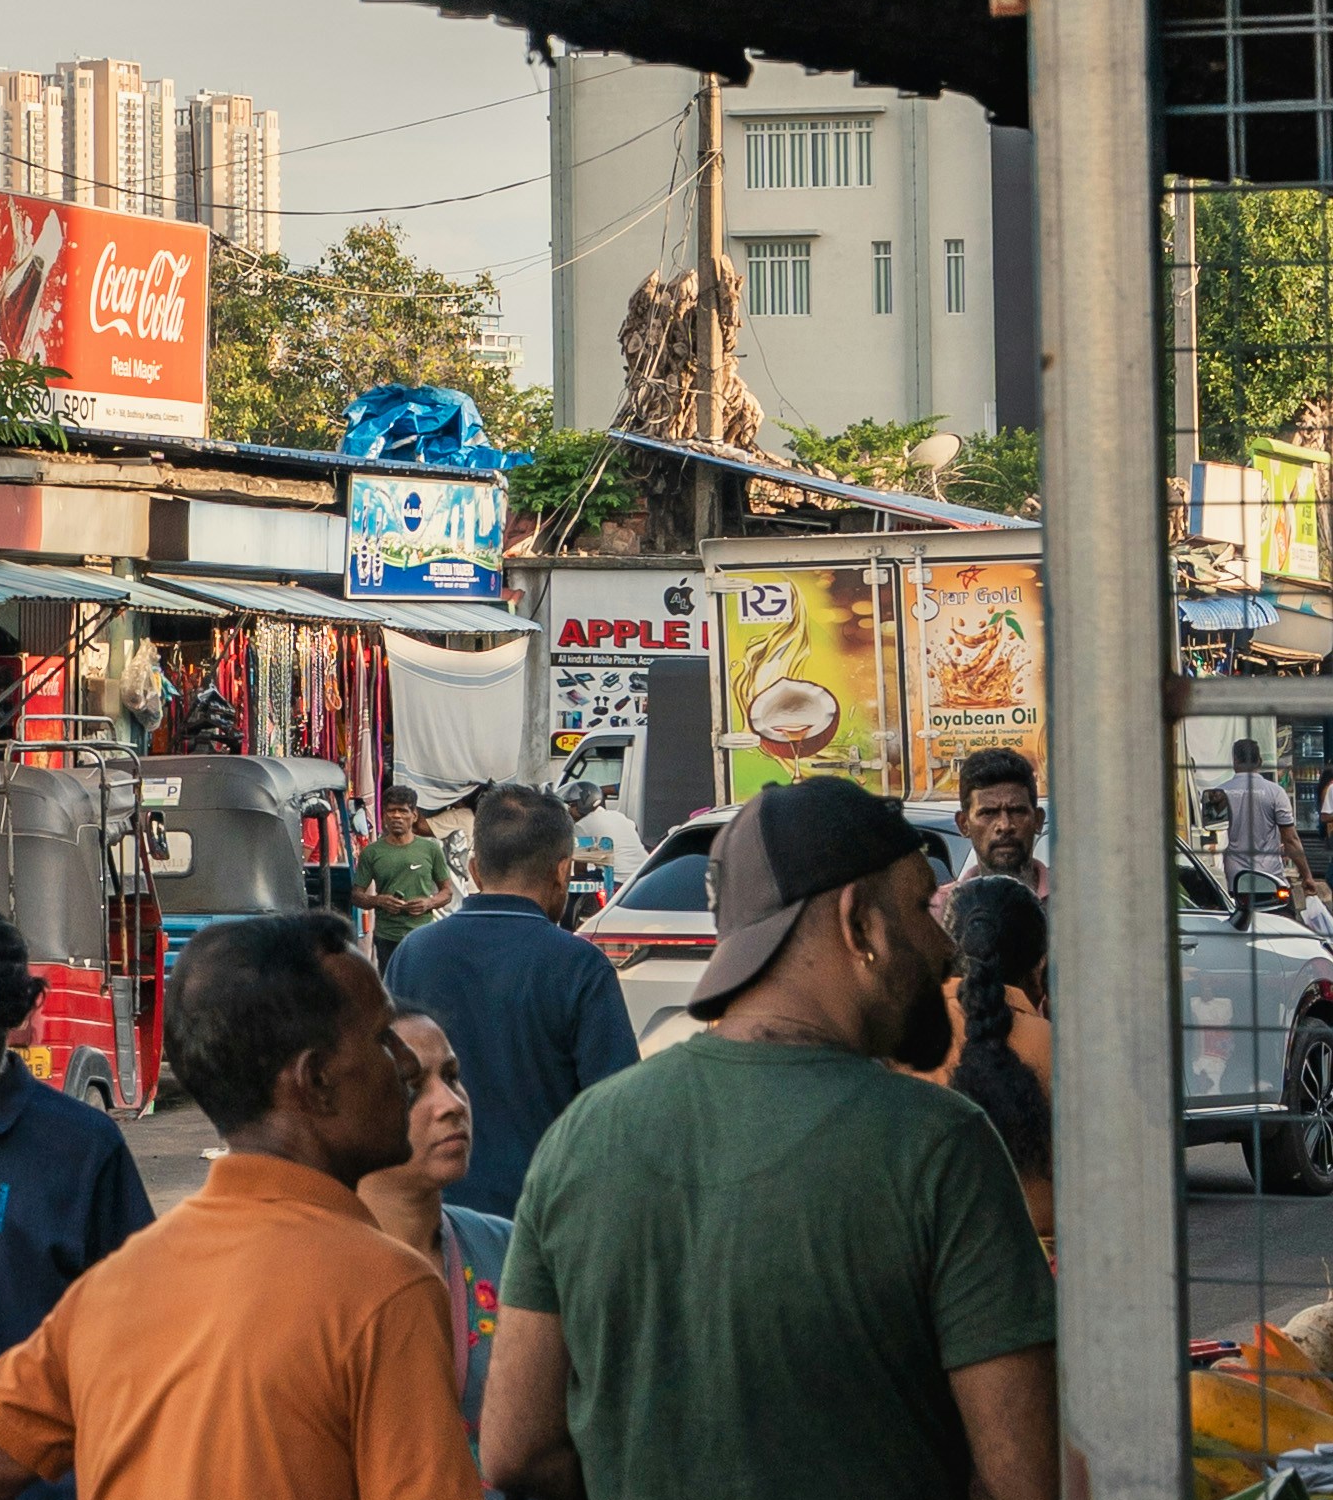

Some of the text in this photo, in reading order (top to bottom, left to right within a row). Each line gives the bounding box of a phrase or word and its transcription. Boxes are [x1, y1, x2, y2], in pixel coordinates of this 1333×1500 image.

[89, 240, 193, 343] Coca-Cola
[111, 356, 162, 384] Real Magic
[63, 394, 97, 421] SPOT
[742, 585, 788, 617] RG
[911, 585, 1023, 622] Star Gold
[557, 618, 691, 650] APPLE
[558, 655, 567, 664] All
[567, 655, 585, 664] kinds
[585, 655, 592, 664] of
[592, 655, 613, 665] Mobile
[930, 708, 1037, 729] oyabean Oil
[168, 786, 178, 797] P
